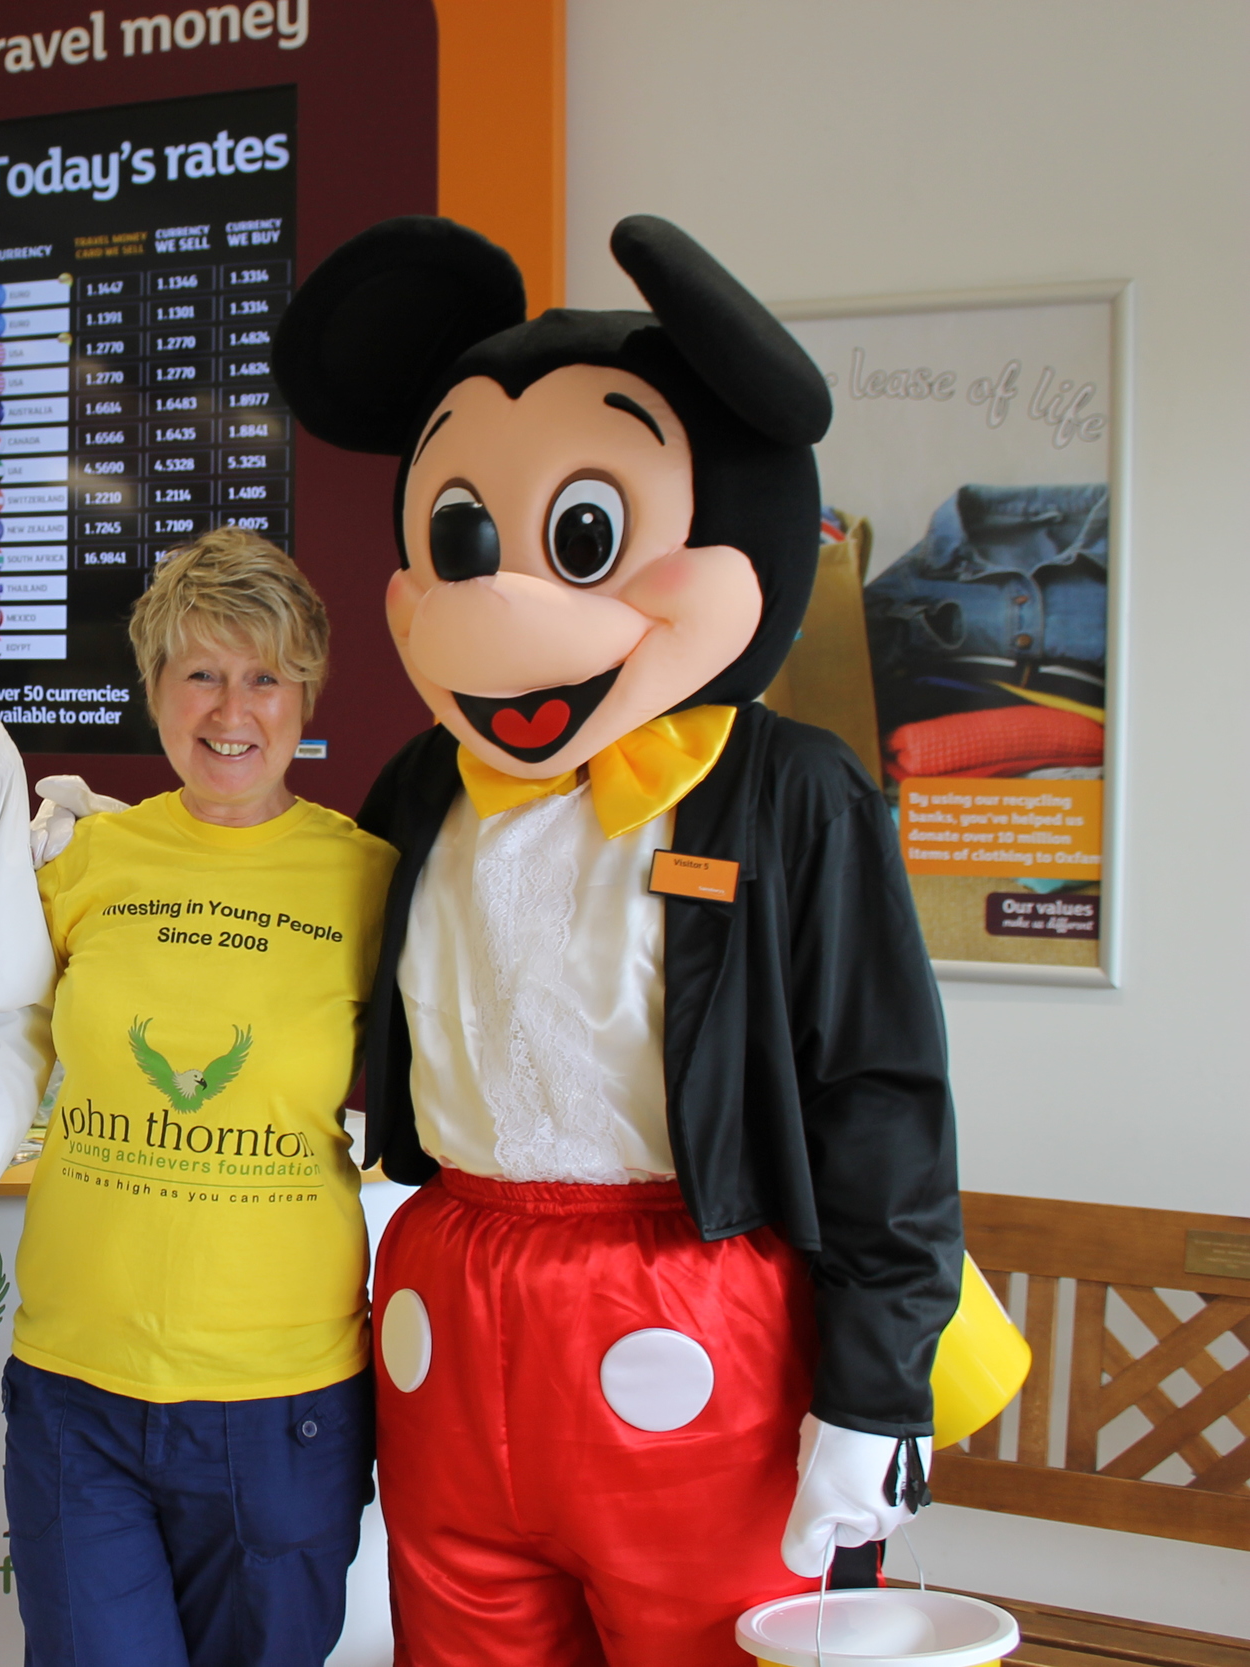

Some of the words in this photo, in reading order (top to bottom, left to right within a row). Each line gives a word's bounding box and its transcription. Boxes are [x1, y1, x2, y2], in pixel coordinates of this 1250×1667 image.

[120, 0, 309, 56] money
[164, 130, 289, 180] rates
[155, 224, 210, 239] CURRENCY
[226, 218, 282, 232] CURRENCY
[155, 239, 176, 253] WE
[179, 236, 210, 251] SELL
[227, 233, 248, 247] WE
[251, 230, 280, 244] BUY
[157, 306, 194, 320] 1.1301
[86, 341, 124, 356] 1.2770
[156, 336, 196, 350] 1.2770
[86, 371, 124, 385] 1.2770
[156, 366, 195, 381] 1.2770
[850, 346, 956, 401] lease
[966, 359, 1021, 430] of
[1028, 366, 1106, 450] life
[8, 405, 52, 416] AUSTRALIA
[8, 436, 40, 446] CANADA
[156, 428, 196, 441] 1.6435
[84, 461, 124, 474] 4.5690
[154, 458, 195, 472] 4.5328
[228, 455, 266, 468] 5.3251
[7, 494, 65, 504] SWITZERLAND
[84, 492, 122, 505] 1.2210
[155, 489, 191, 502] 1.2114
[228, 486, 266, 500] 1.4105
[7, 525, 24, 534] NEW
[27, 524, 64, 533] ZEALAND
[155, 519, 193, 532] 1.7109
[7, 554, 32, 564] SOUTH
[34, 554, 64, 563] AFRICA
[84, 552, 126, 565] 16.9841
[6, 584, 47, 592] THAILAND
[6, 613, 36, 622] MEXICO
[6, 643, 30, 652] EGYPT
[24, 685, 43, 701] 50
[46, 685, 130, 702] currencies
[58, 709, 76, 724] to
[78, 708, 121, 725] order
[909, 792, 929, 807] By
[931, 794, 972, 808] using
[975, 796, 999, 806] our
[1002, 794, 1072, 810] recycling
[1011, 813, 1062, 827] helped
[1066, 816, 1084, 826] us
[909, 830, 959, 842] donate
[962, 833, 994, 843] over
[1017, 832, 1071, 844] million
[674, 858, 701, 869] Visitor
[909, 848, 950, 860] items
[953, 848, 970, 860] of
[971, 849, 1033, 866] clothing
[1037, 851, 1051, 863] to
[1002, 900, 1033, 914] Our
[1037, 900, 1093, 916] values
[186, 899, 203, 914] in
[208, 900, 271, 928] Young
[277, 913, 344, 942] People
[157, 927, 212, 945] Since
[218, 931, 268, 952] 2008
[145, 1109, 314, 1158] thornton
[68, 1138, 110, 1163] young
[116, 1151, 211, 1173] achievers
[217, 1161, 320, 1176] foundation
[62, 1166, 90, 1183] climb
[95, 1176, 109, 1187] as
[116, 1180, 151, 1195] high
[160, 1188, 178, 1198] as
[188, 1190, 219, 1202] you
[230, 1192, 259, 1203] can
[268, 1192, 318, 1203] dream
